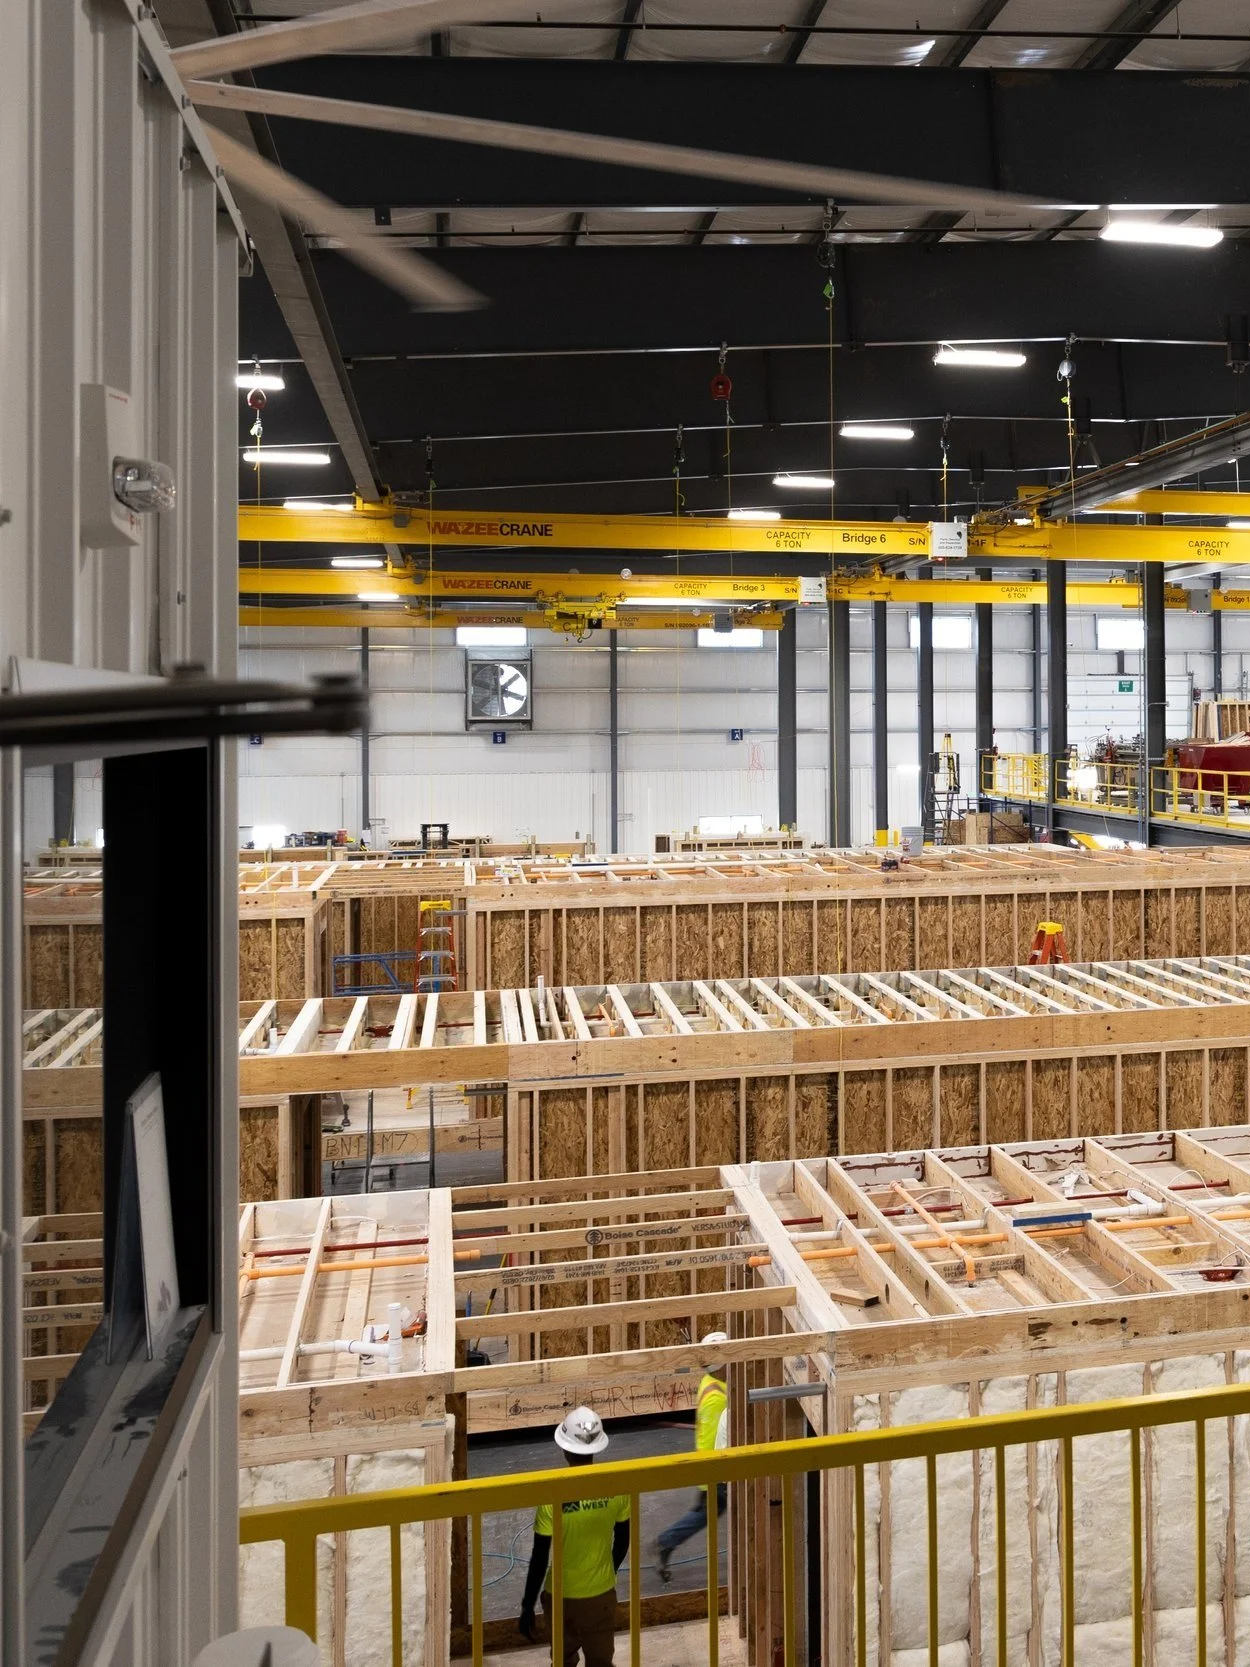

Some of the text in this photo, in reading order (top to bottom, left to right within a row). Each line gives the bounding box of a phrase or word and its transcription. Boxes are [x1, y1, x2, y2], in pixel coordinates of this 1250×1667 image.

[766, 531, 812, 541] CAPACITY
[843, 533, 887, 545] Bridge 6
[908, 537, 926, 546] S/N
[733, 584, 766, 593] Bridge 3
[563, 621, 572, 631] C
[605, 1230, 634, 1240] Boise
[590, 1385, 648, 1417] FIRE
[582, 1499, 609, 1511] WEST
